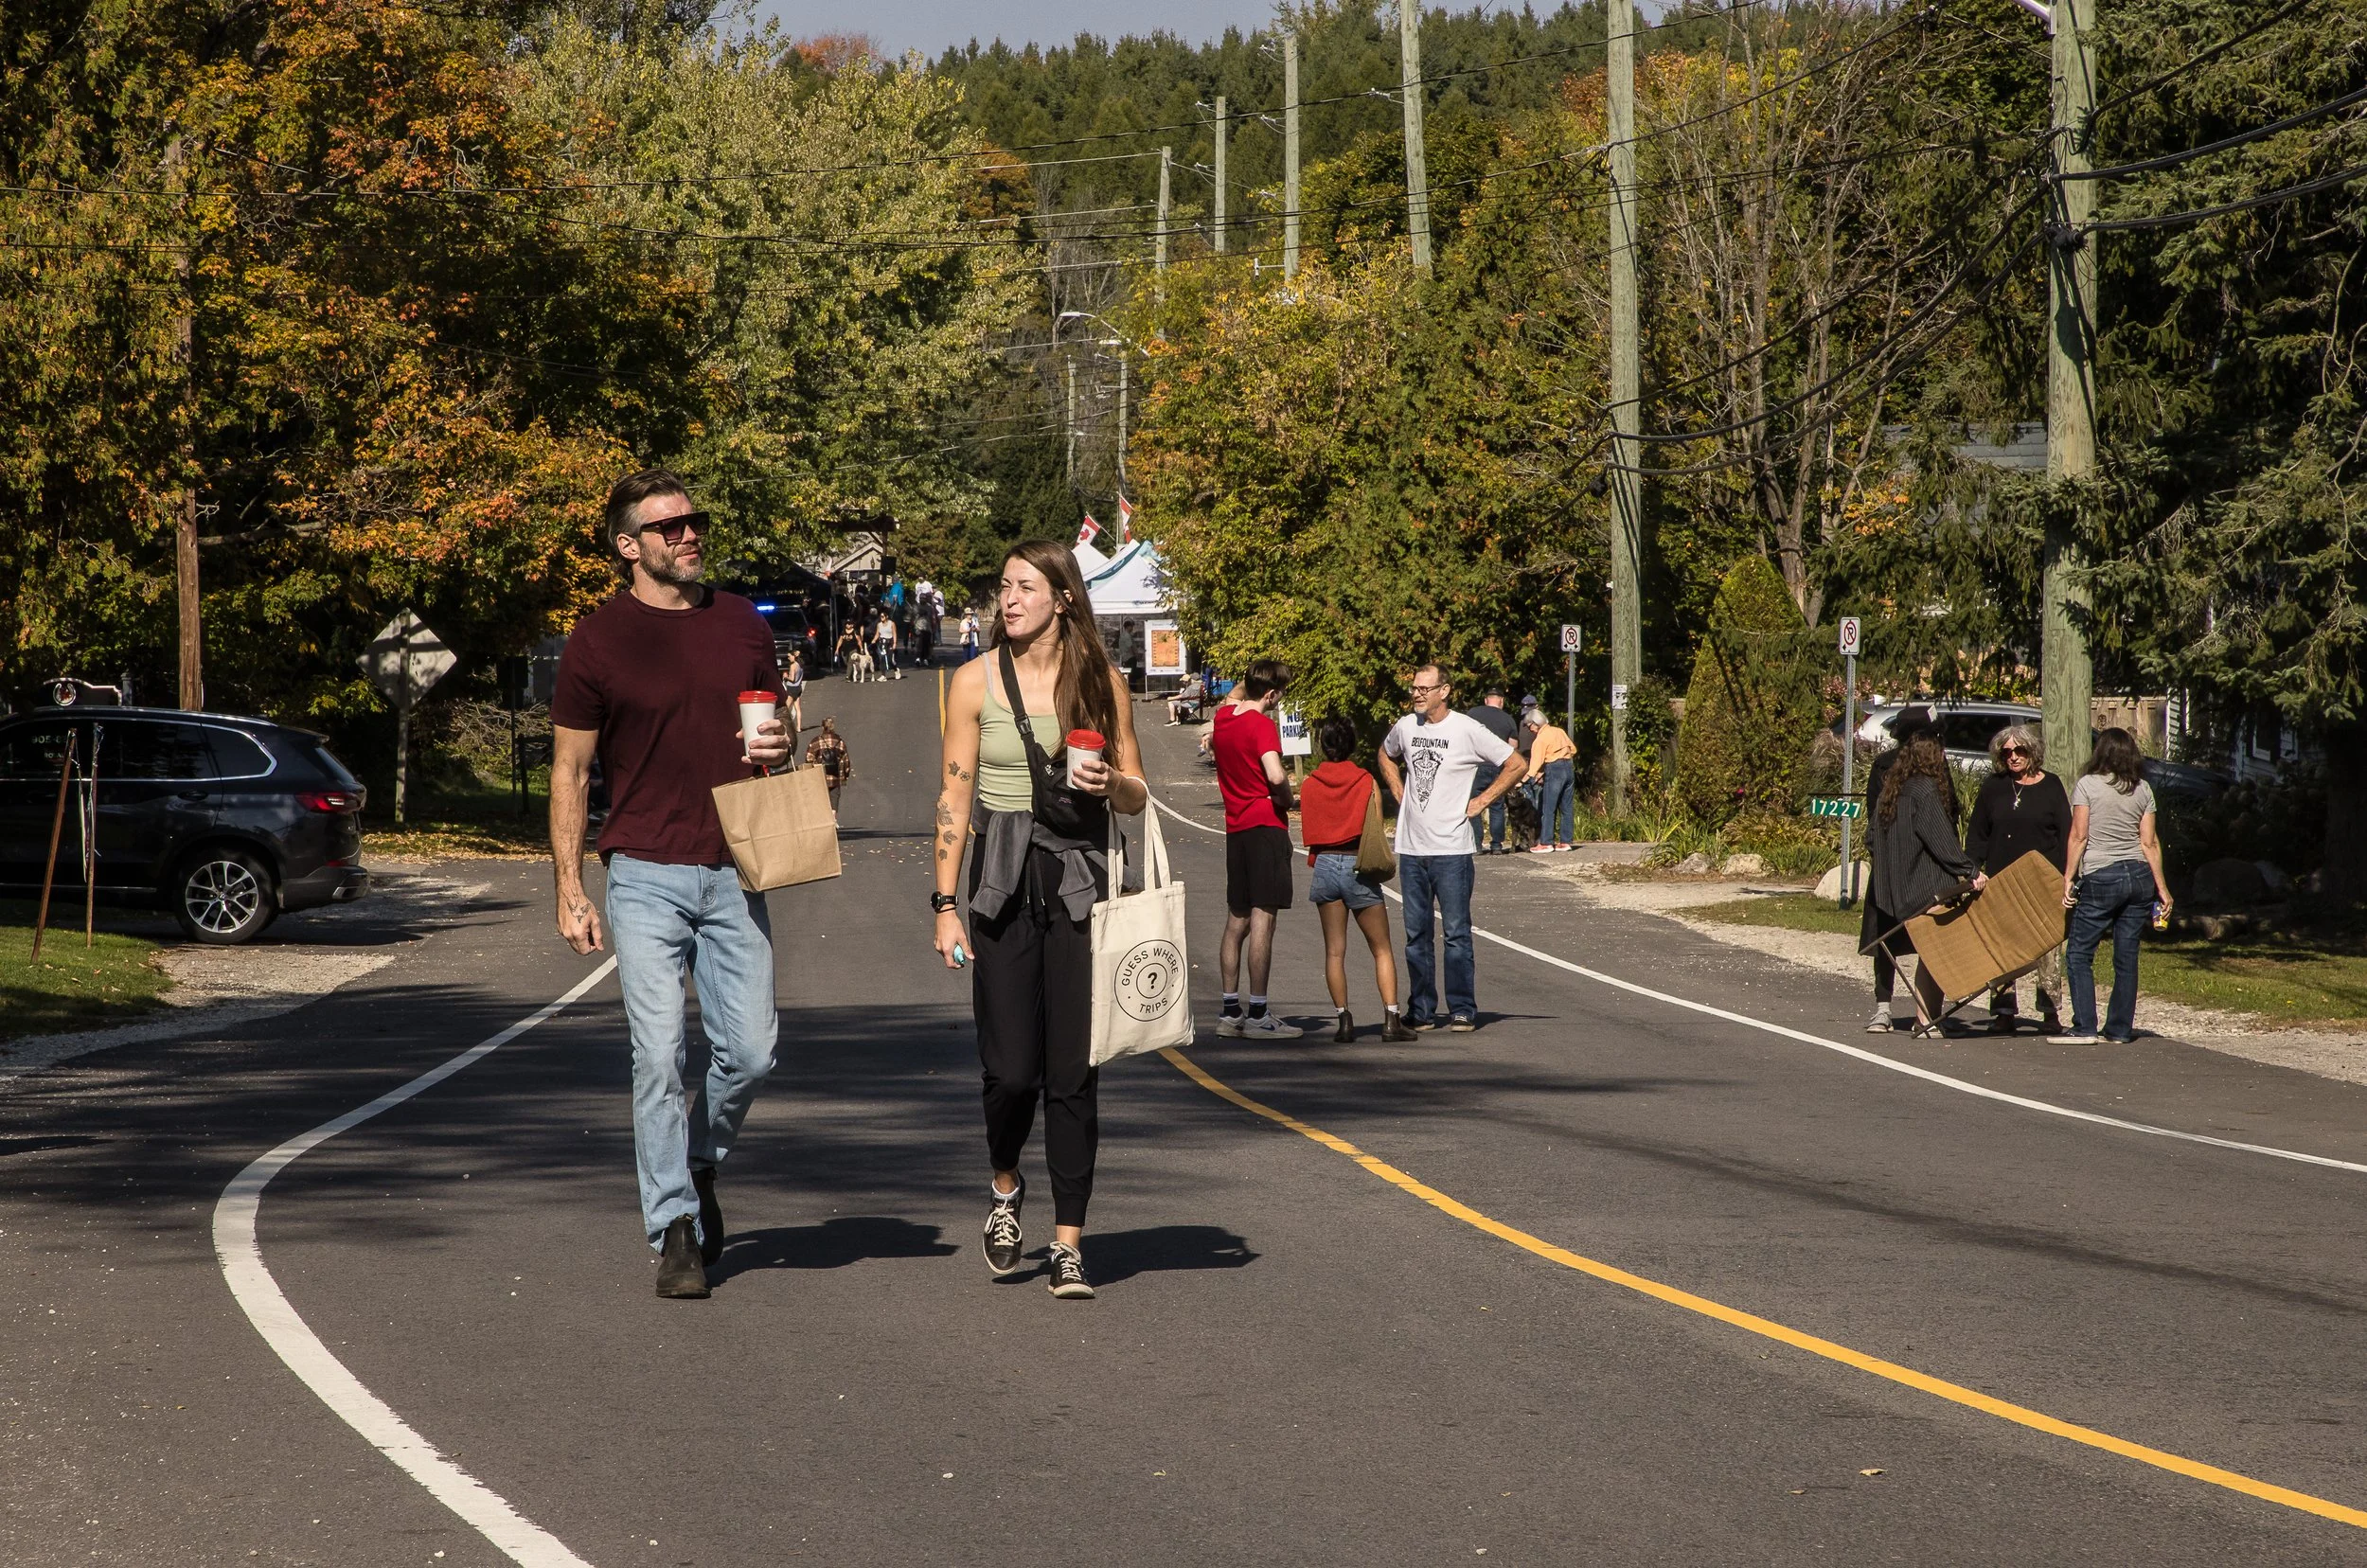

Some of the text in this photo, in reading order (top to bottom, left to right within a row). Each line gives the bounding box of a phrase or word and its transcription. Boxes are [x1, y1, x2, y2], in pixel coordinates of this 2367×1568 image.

[1282, 724, 1308, 738] PARKI
[1411, 737, 1450, 749] BELFOUNTAIN
[1811, 798, 1861, 818] 17227
[1121, 948, 1179, 987] GUESS WHERE
[1147, 971, 1158, 989] ?
[1139, 997, 1168, 1014] TRIPS
